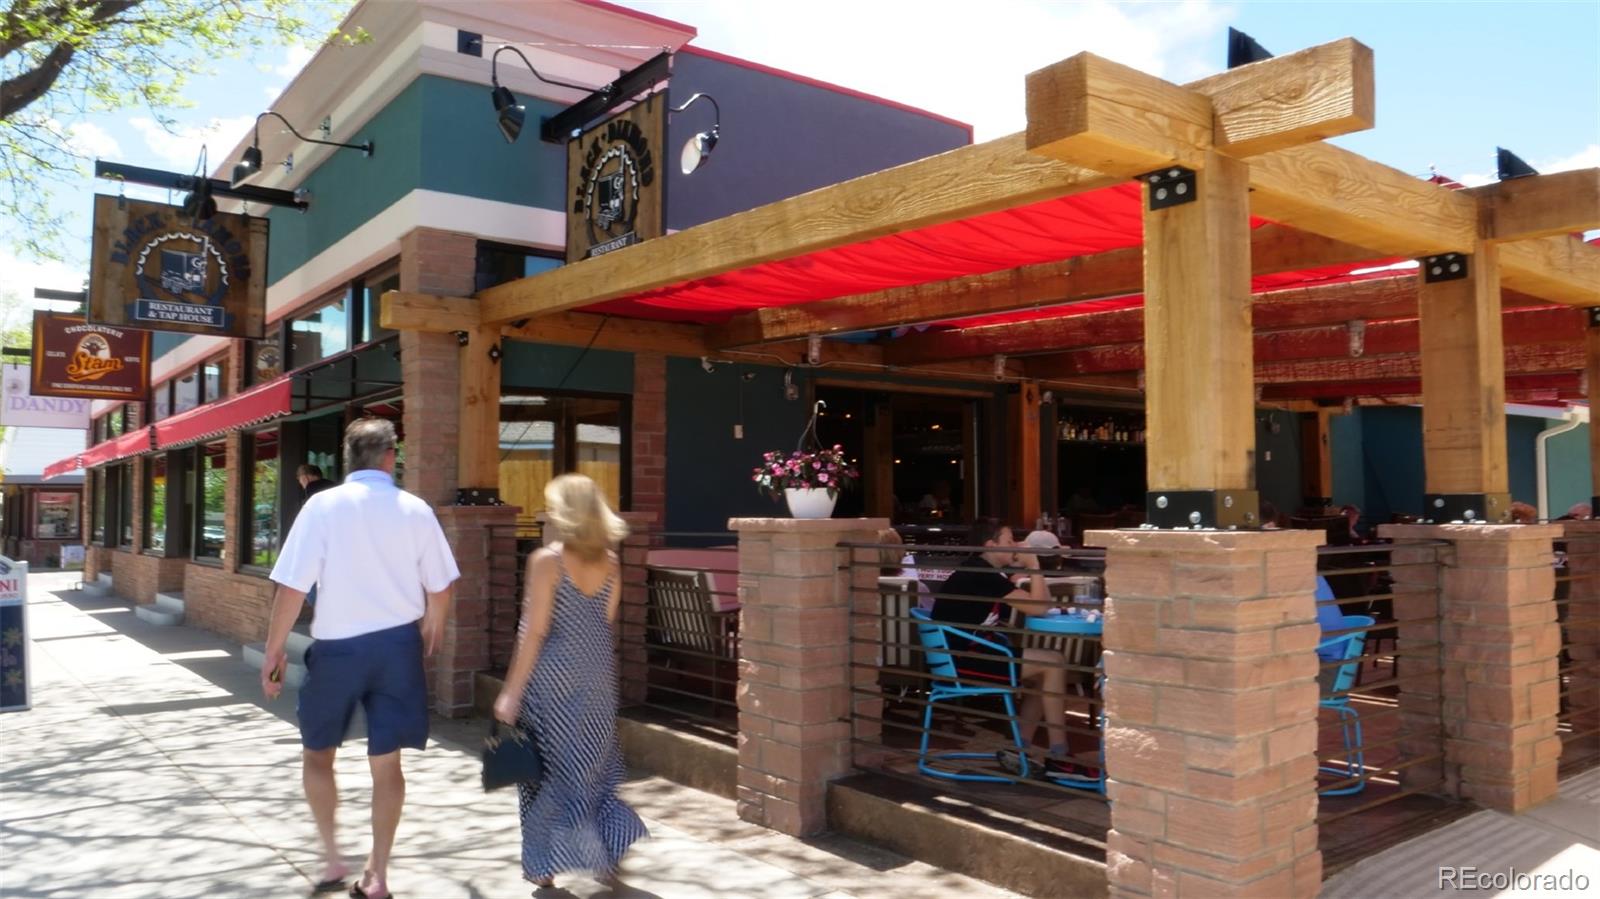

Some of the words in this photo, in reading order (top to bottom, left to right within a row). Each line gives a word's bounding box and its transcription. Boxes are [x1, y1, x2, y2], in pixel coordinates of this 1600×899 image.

[148, 302, 214, 316] RESTAURANT
[148, 310, 157, 318] &
[158, 311, 178, 320] TAP
[179, 313, 214, 324] HOUSE
[9, 396, 85, 413] DANDY
